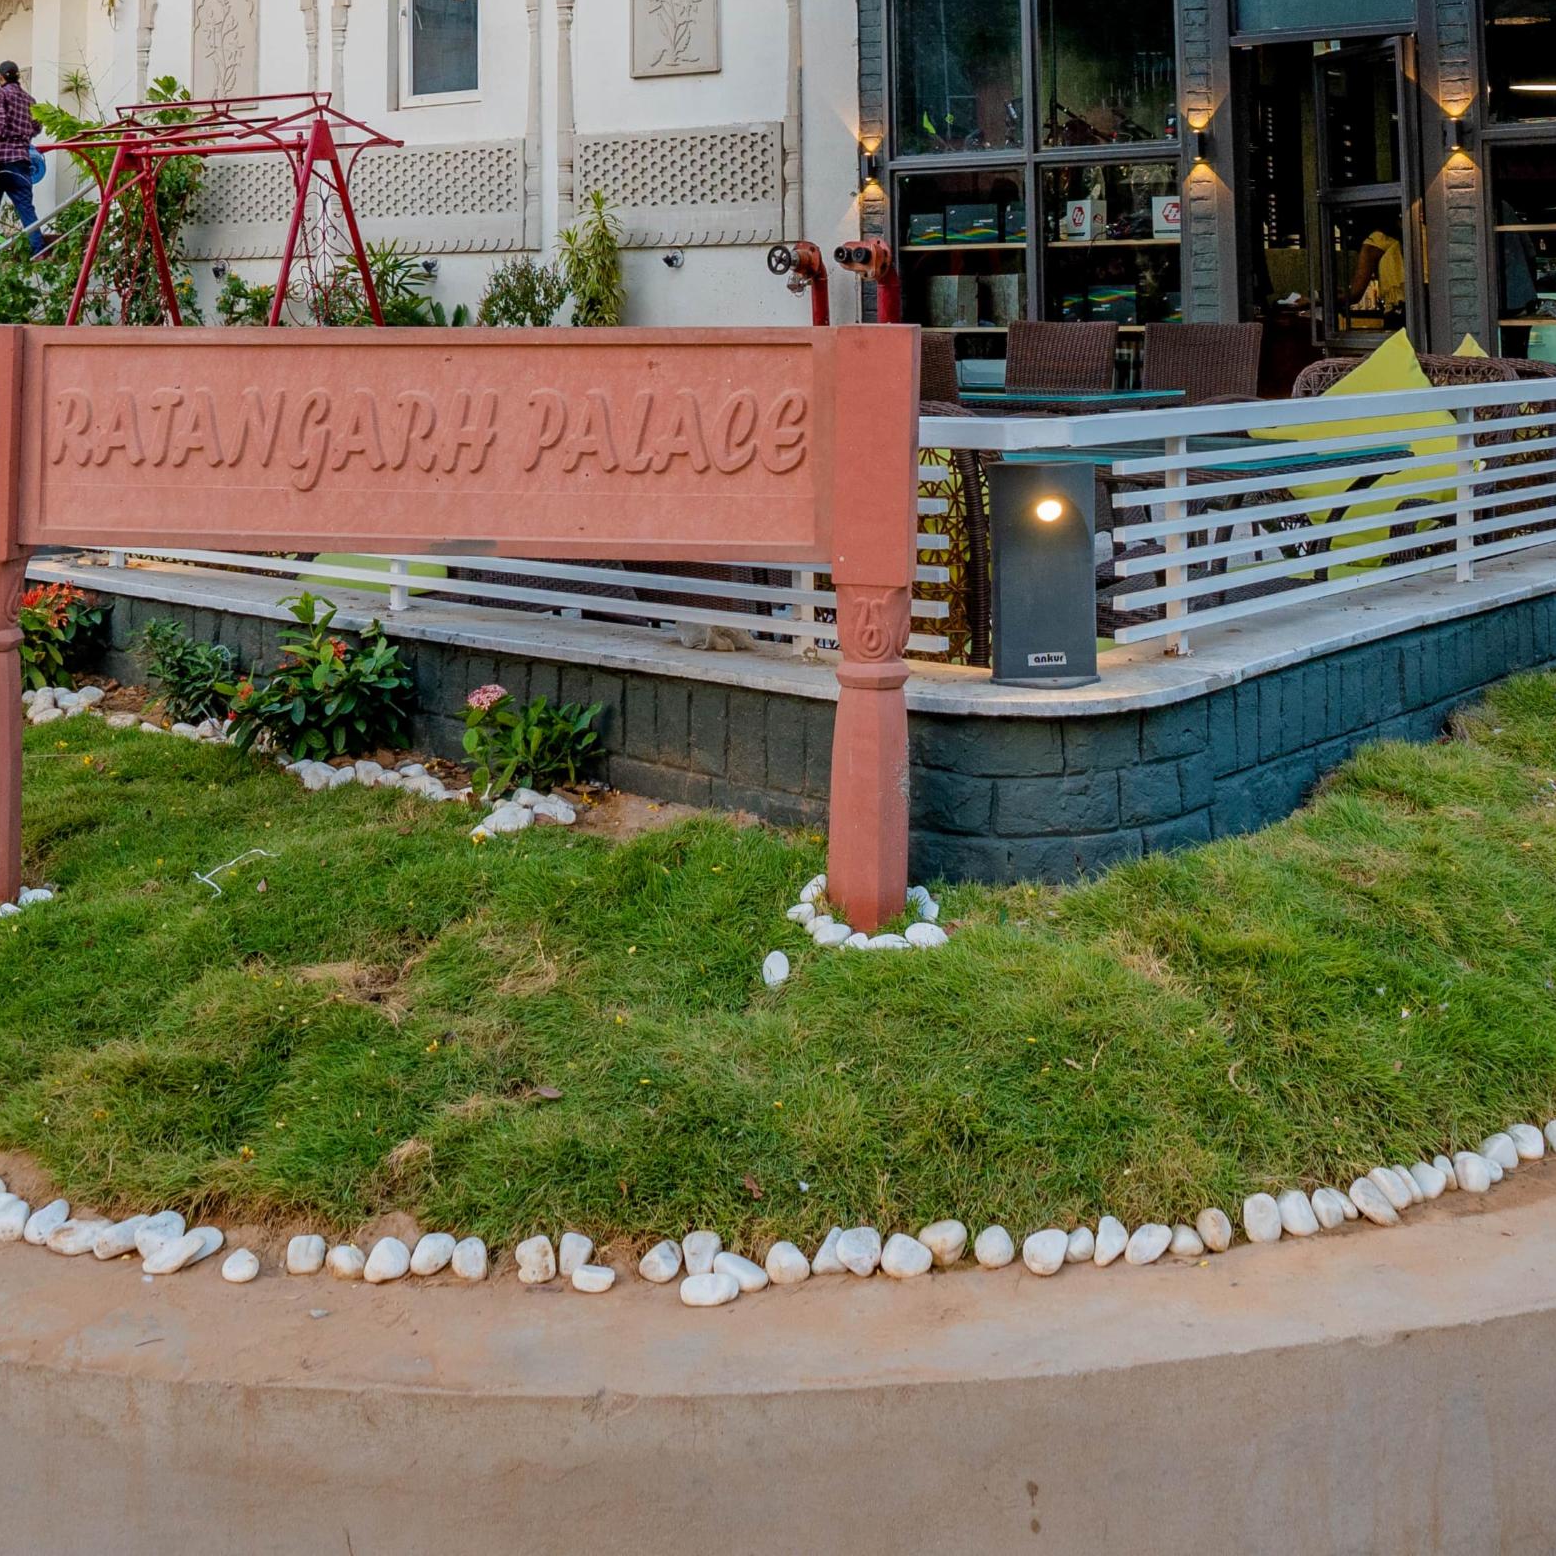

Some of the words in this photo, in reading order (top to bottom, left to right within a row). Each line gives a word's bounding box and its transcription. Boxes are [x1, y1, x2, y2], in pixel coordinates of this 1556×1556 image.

[50, 387, 500, 491] RATANGARH
[524, 387, 808, 475] PALACE
[1034, 653, 1064, 664] ankur
